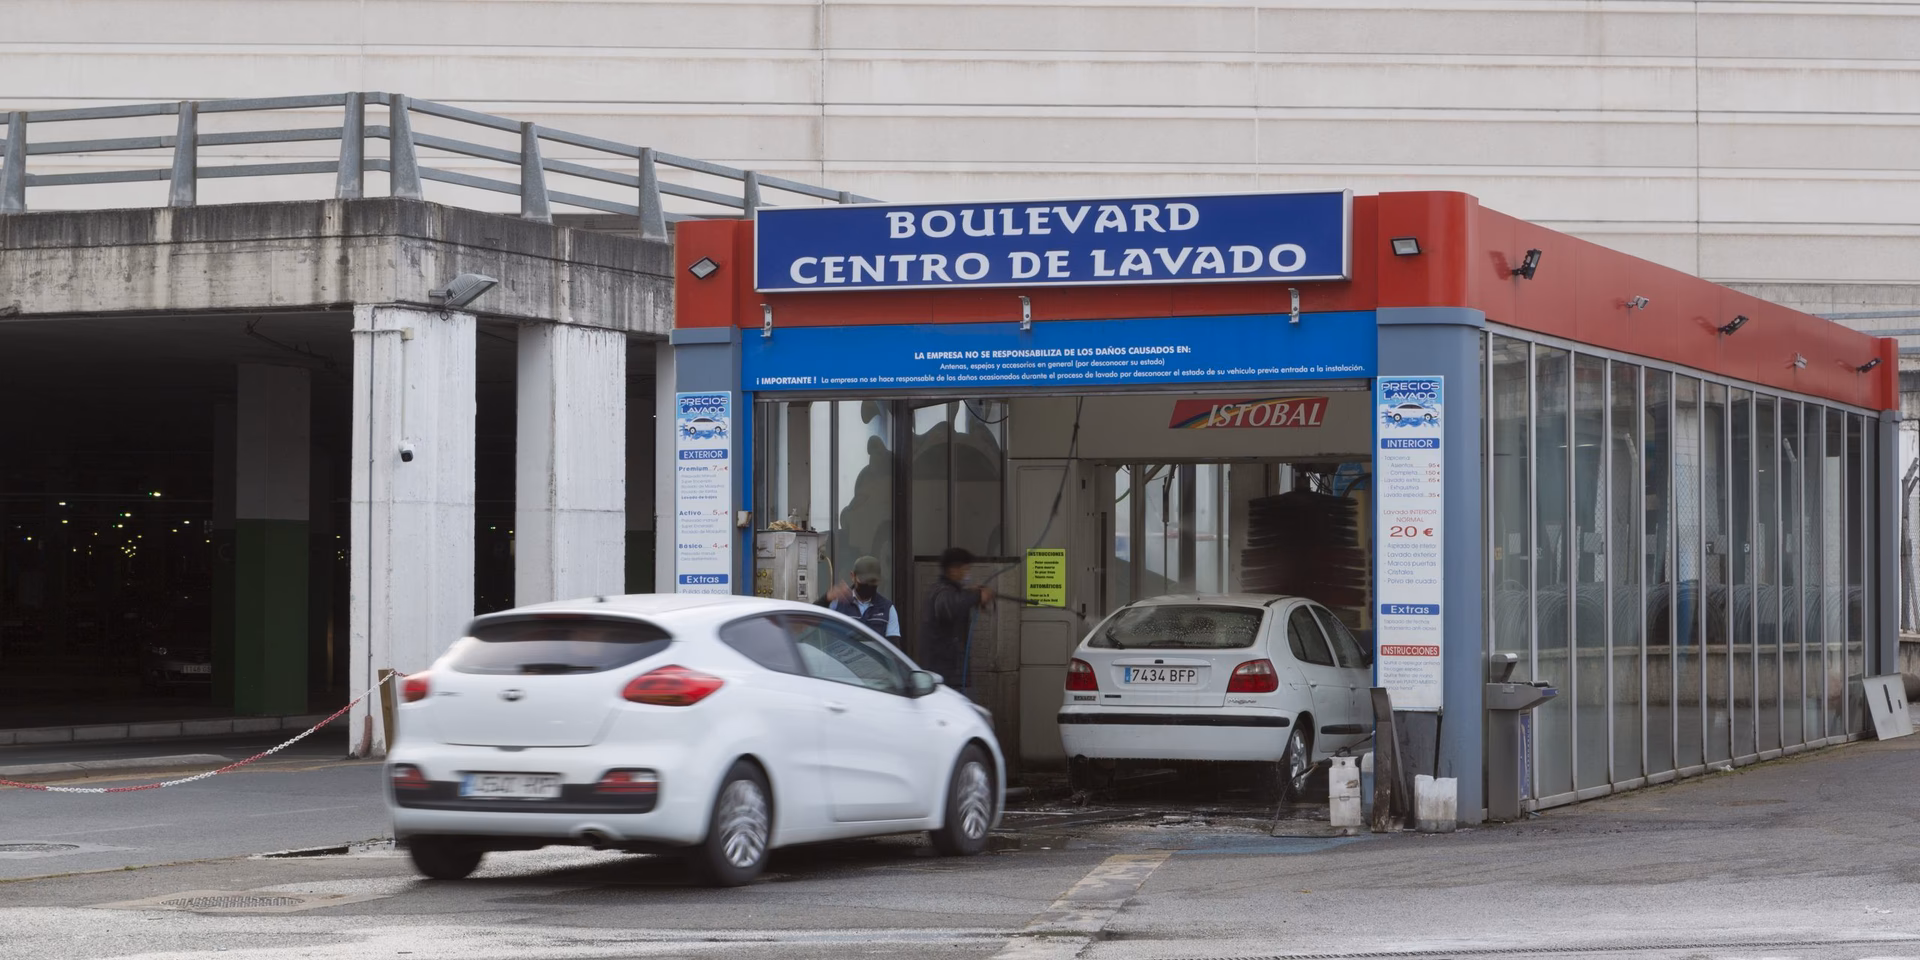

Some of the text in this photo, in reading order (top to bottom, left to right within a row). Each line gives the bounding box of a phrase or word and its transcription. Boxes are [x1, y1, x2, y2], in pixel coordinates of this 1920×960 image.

[886, 203, 1200, 239] BOULEVARD
[790, 244, 1306, 284] CENTRO DE LAVADO
[992, 349, 1062, 358] RESPONSABILIZA
[1128, 346, 1174, 354] CAUSADOS
[1048, 360, 1073, 369] general
[1075, 360, 1089, 368] (por
[761, 376, 812, 385] IMPORTANTE
[896, 375, 934, 383] responsable
[1206, 403, 1320, 427] ISTOBAL
[1390, 526, 1433, 537] 20 €
[1383, 646, 1437, 655] INSTRUCCIONES
[1132, 669, 1195, 682] 7434 BFP
